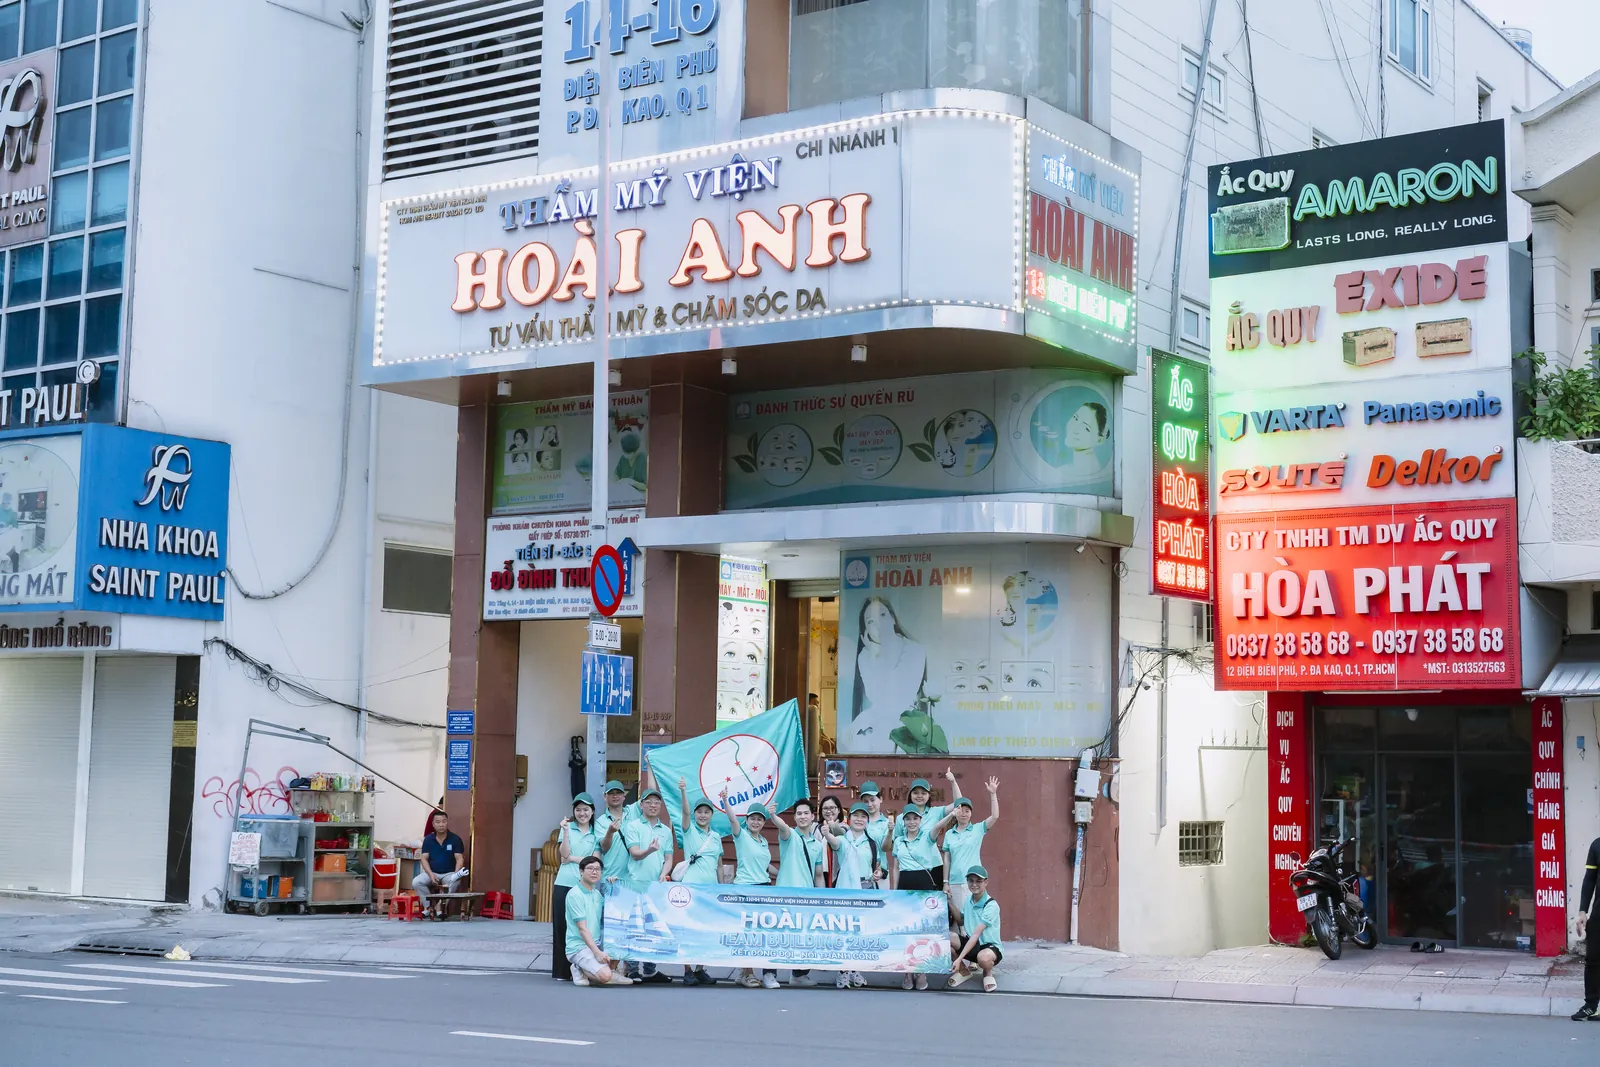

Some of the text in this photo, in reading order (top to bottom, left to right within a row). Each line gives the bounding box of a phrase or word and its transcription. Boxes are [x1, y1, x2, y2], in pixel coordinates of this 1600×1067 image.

[618, 56, 664, 90] BIÊN
[676, 40, 718, 78] PHỦ
[583, 106, 600, 130] Đ
[795, 139, 823, 159] CHI
[828, 127, 886, 155] NHÁNH
[11, 185, 47, 206] PAUL
[499, 152, 783, 231] THẨM MỸ VIỆN
[1079, 172, 1098, 204] MỸ
[1100, 180, 1125, 218] VIỆN
[1217, 165, 1295, 196] Ắc Quy
[1292, 155, 1498, 221] AMARON
[1030, 191, 1135, 293] HOÀI ANH
[1297, 214, 1496, 249] LASTS LONG, REALLY LONG.
[451, 192, 874, 313] HOÀI ANH
[1333, 255, 1489, 314] EXIDE
[489, 285, 827, 347] TƯ VẤN THẨ MỸ & CHĂM SÓC DA
[1226, 300, 1321, 351] ẮC QUY
[20, 382, 84, 425] PAUL
[612, 394, 644, 408] THUẬN
[1250, 390, 1503, 434] VARTA Panasonic
[1157, 364, 1205, 561] ẮC QUY HÒA PHÁT
[1219, 447, 1503, 496] SOLITE Delkor
[101, 517, 219, 559] NHA KHOA
[515, 542, 541, 560] TIẾN
[561, 541, 583, 561] BÁC
[1226, 514, 1498, 551] CTY TNHH TM DV ẮC QUY
[25, 564, 69, 597] MẤT
[90, 564, 225, 604] SAINT PAUL
[490, 559, 557, 591] ĐỖ ĐÌNH
[875, 565, 973, 588] HOÀI ANH
[1231, 550, 1492, 619] HÒA PHÁT
[66, 621, 113, 648] RĂNG
[1226, 626, 1504, 658] 0837 38 58 68 0937 38 58 68
[1226, 666, 1234, 677] 12
[1237, 664, 1255, 679] ĐIỆN
[1257, 663, 1277, 676] BIÊN
[1300, 665, 1308, 676] P.
[1310, 664, 1322, 676] ĐA
[1324, 664, 1343, 677] KAO,
[1363, 663, 1396, 675] TP.HCM
[1452, 661, 1506, 674] 0313527563
[752, 780, 774, 799] ANH
[1273, 711, 1302, 842] DỊCH VỤ ẮC QUY CHUYÊN
[1534, 704, 1565, 909] ẮC QUY CHÍNH HÃNG GIÁ PHẢI CHĂNG
[740, 907, 866, 932] HOÀI ANH
[719, 931, 890, 951] TEAM BUILDING 2026
